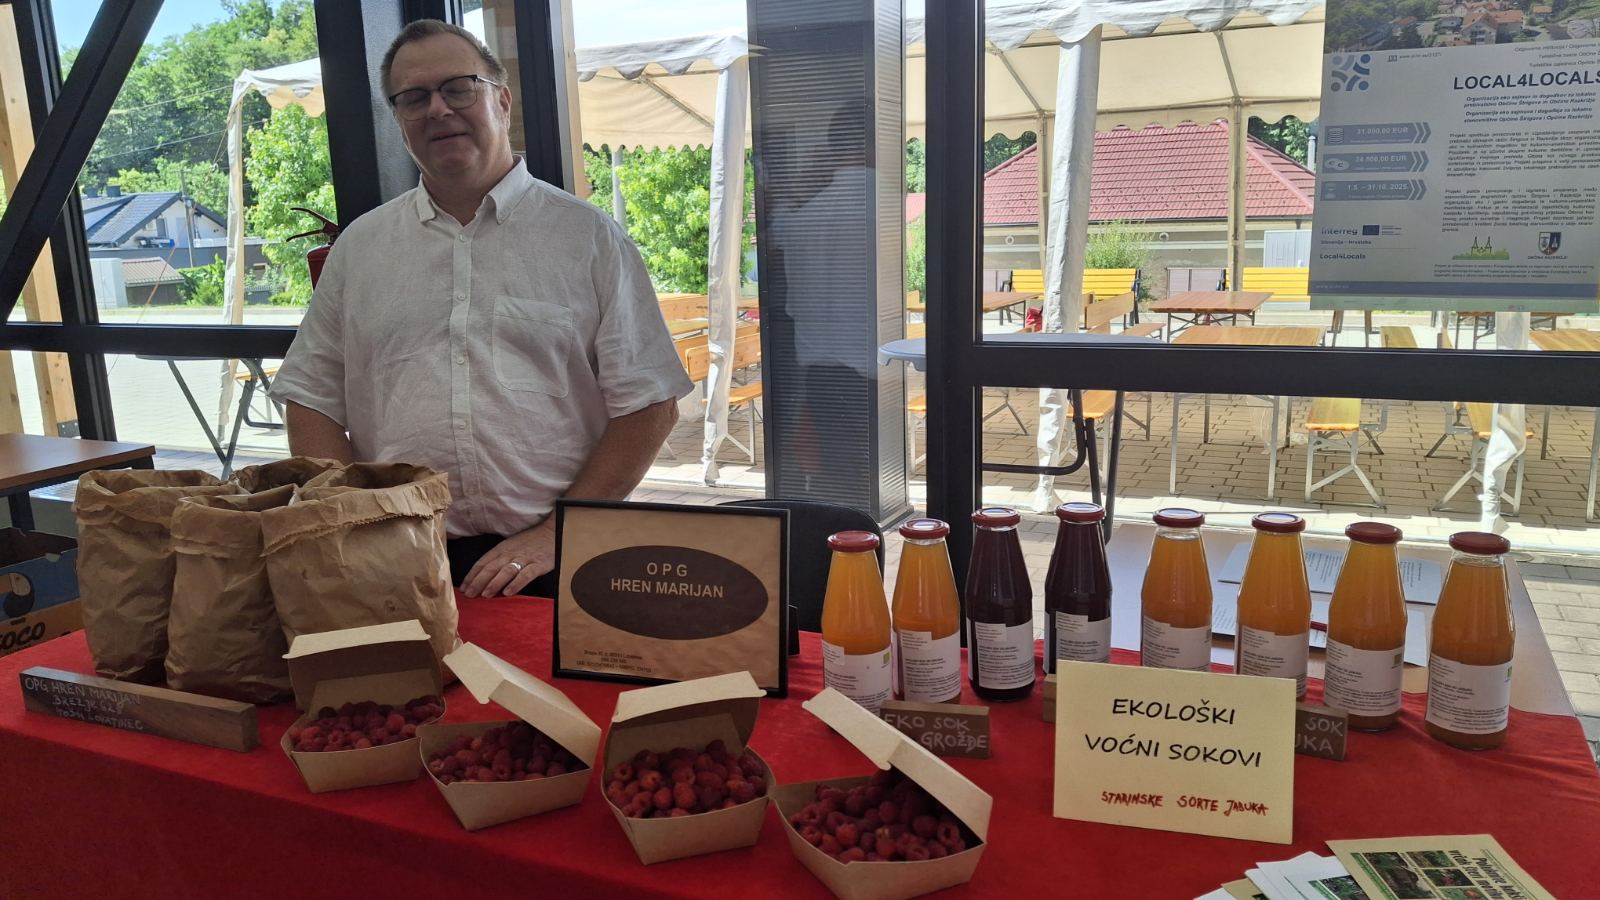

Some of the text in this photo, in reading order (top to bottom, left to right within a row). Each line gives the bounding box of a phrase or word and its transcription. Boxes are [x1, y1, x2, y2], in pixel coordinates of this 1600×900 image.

[611, 577, 724, 599] HREN MARIJAN
[25, 676, 141, 708] OPG HREN MARIJAN
[884, 713, 971, 731] EKO SOK
[1111, 698, 1236, 725] EKOLOŠKI
[1304, 717, 1344, 737] SOK
[1084, 733, 1262, 767] VOĆNI SOKOVI
[1101, 791, 1163, 808] STARINSKE
[1176, 795, 1218, 812] SORTE
